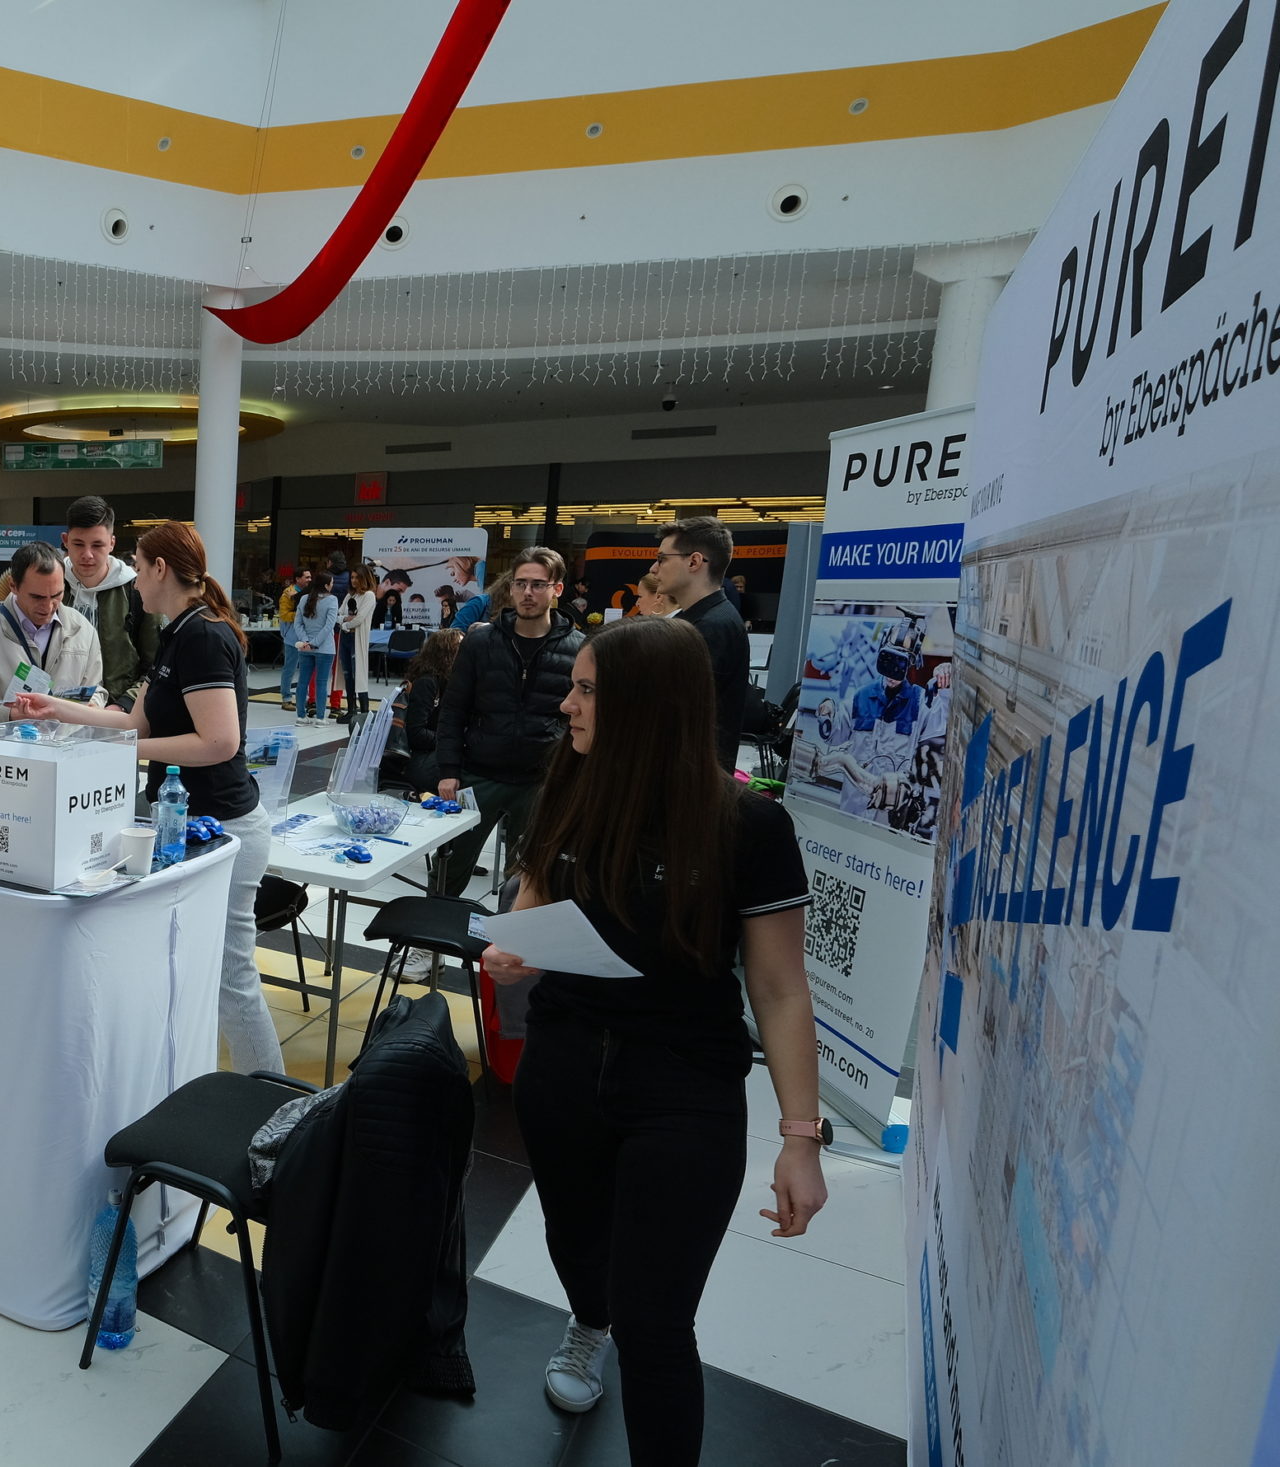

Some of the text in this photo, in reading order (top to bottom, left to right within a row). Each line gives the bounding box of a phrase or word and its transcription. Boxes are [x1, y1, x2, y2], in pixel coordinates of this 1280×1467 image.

[1099, 290, 1280, 467] by Eberspäche
[842, 433, 967, 492] PURE
[906, 490, 924, 505] by
[828, 543, 873, 568] MAKE
[876, 541, 918, 566] YOUR
[68, 783, 126, 814] PUREM
[12, 813, 32, 825] here!
[805, 838, 842, 864] career
[844, 853, 882, 881] starts
[884, 865, 924, 899] here!
[805, 969, 854, 1006] o@purem.com
[834, 1008, 855, 1028] street,
[865, 1026, 875, 1040] 20
[816, 1038, 870, 1090] em.com
